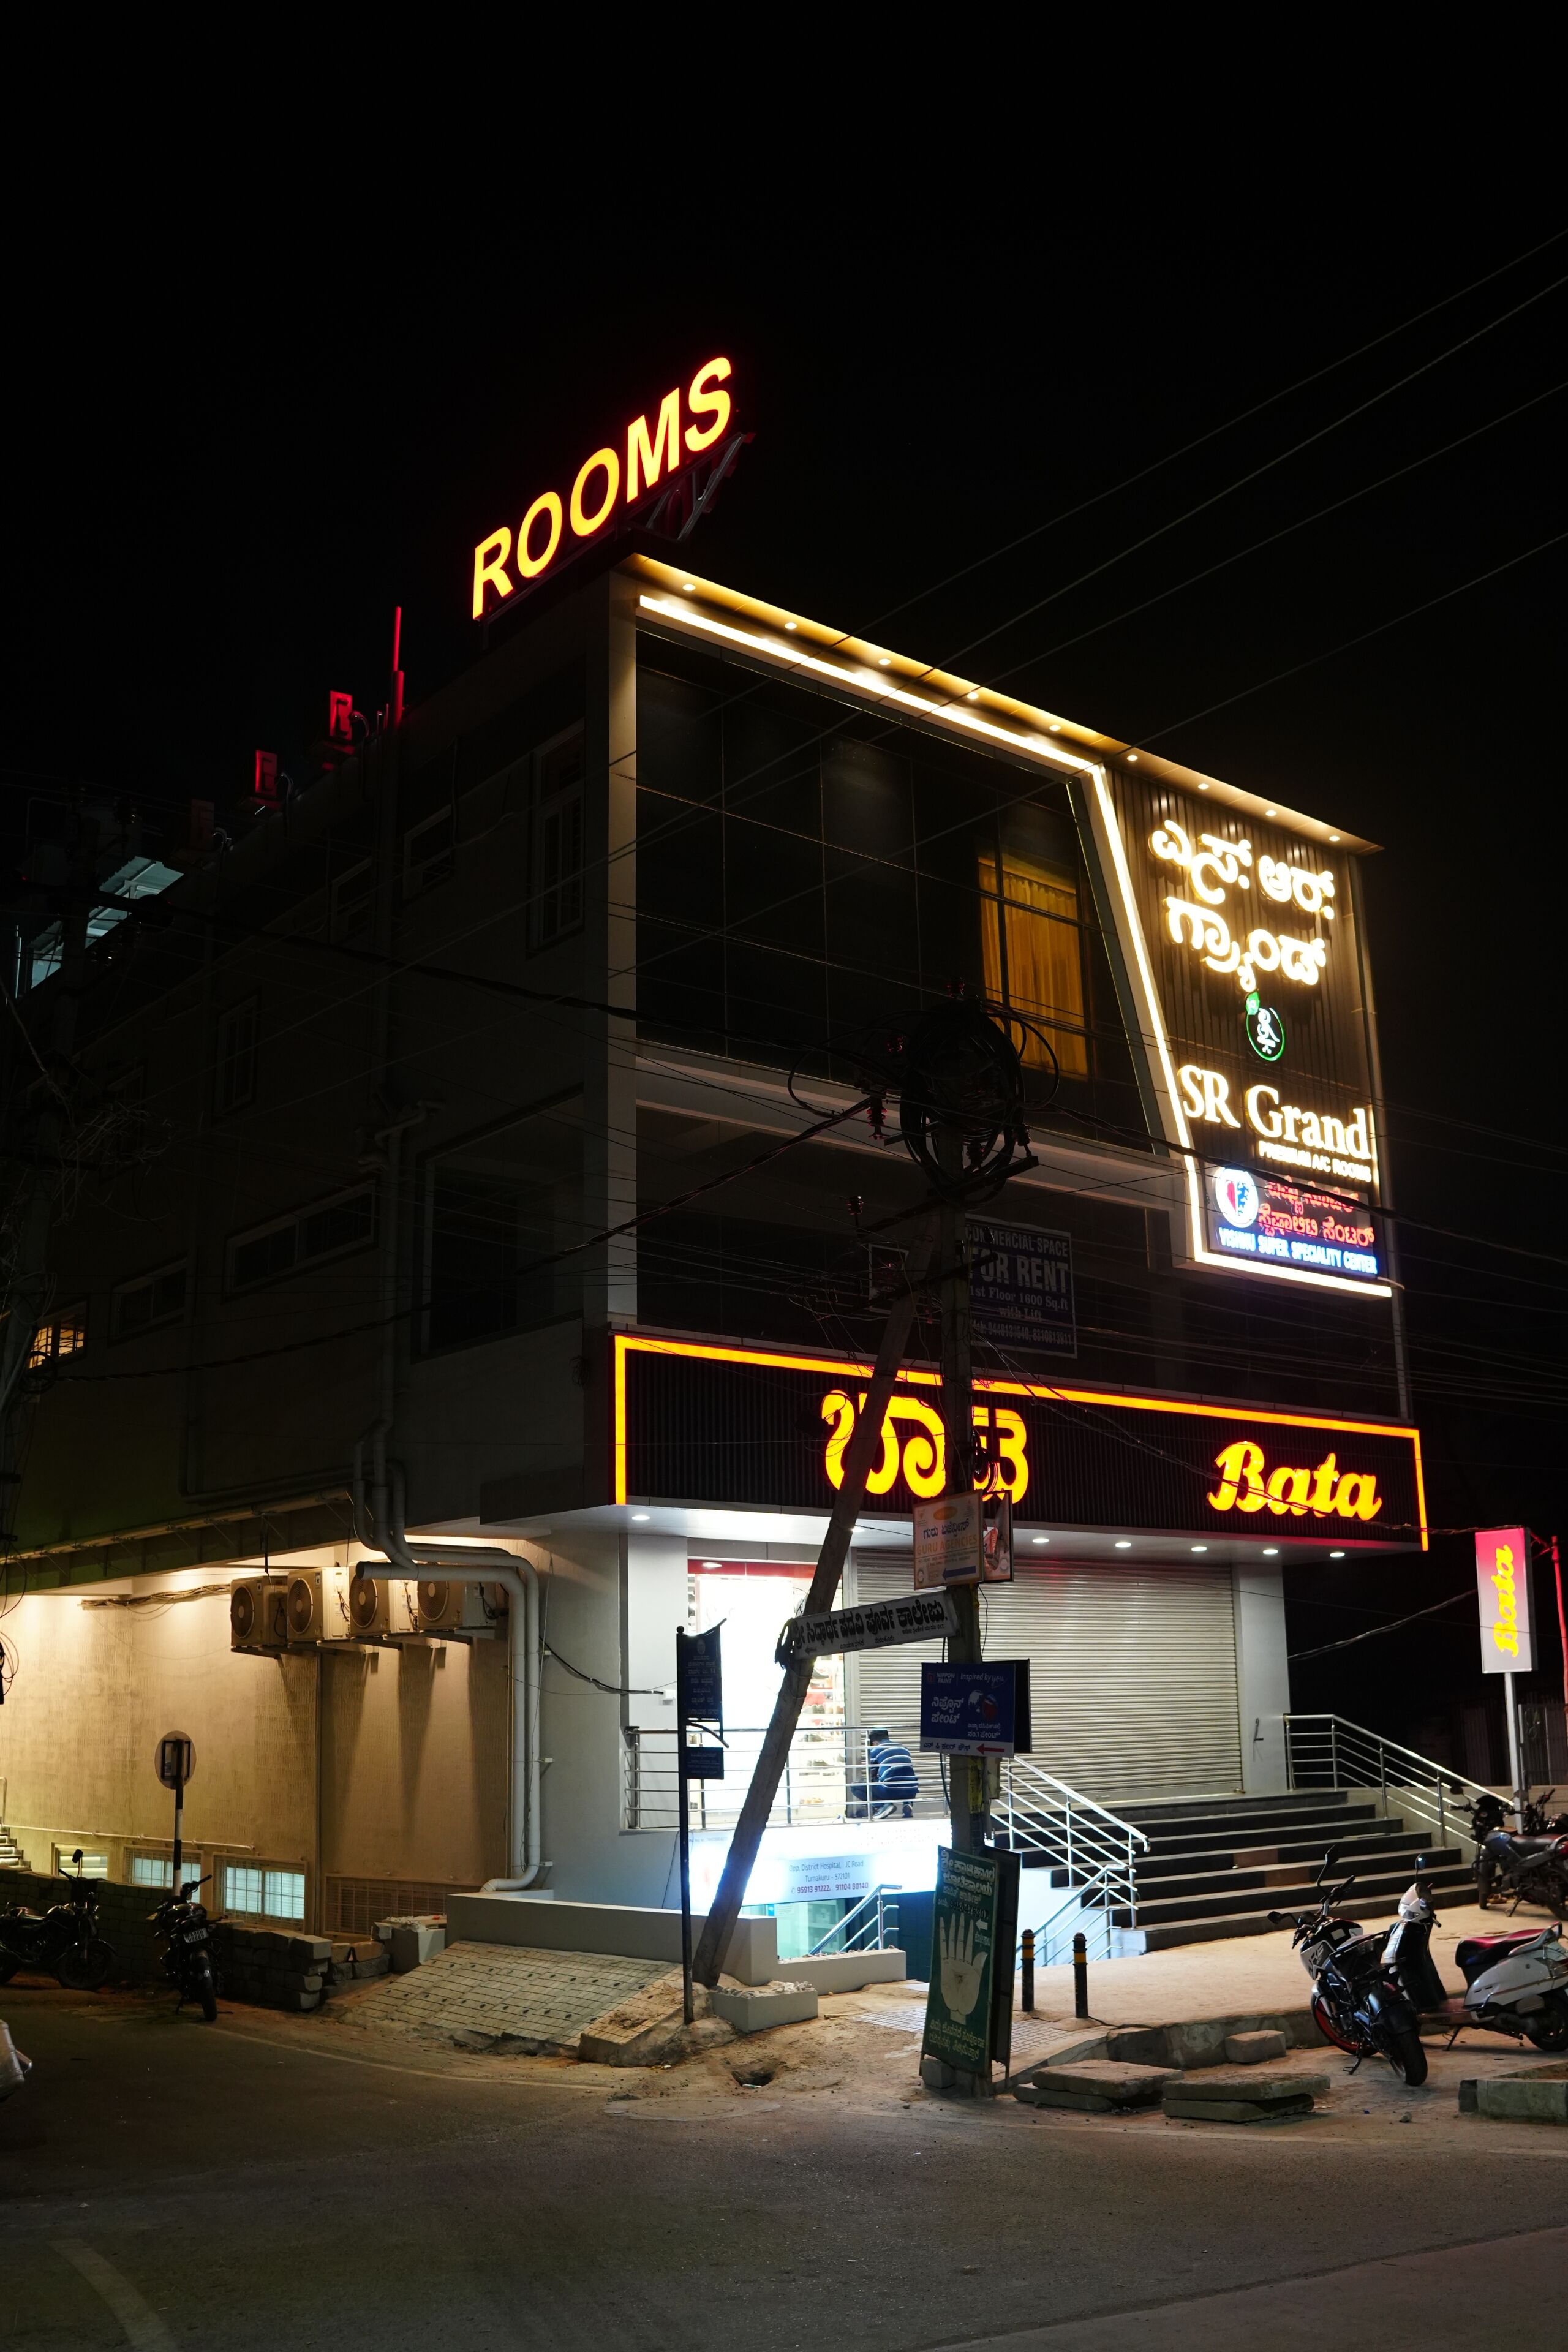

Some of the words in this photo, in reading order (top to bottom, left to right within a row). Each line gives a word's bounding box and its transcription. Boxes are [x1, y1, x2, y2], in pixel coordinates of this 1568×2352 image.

[473, 357, 731, 620] ROOMS
[1178, 1065, 1242, 1128] SR
[1246, 1085, 1372, 1160] Grand
[1259, 1140, 1311, 1168] PREMIUM
[1332, 1158, 1372, 1182] ROOMS
[965, 1224, 1035, 1252] COMERCIAL
[1037, 1237, 1068, 1257] SPACE
[1218, 1227, 1256, 1251] VISHNU
[1257, 1235, 1290, 1258] SUPER
[1291, 1241, 1342, 1268] SPECIALITY
[1343, 1251, 1378, 1275] CENTER
[1017, 1254, 1068, 1294] RENT
[989, 1287, 1016, 1302] Floor
[1019, 1293, 1042, 1306] 1600
[1206, 1440, 1382, 1521] Bata
[916, 1542, 938, 1555] GURU
[940, 1534, 978, 1551] AGENCIES
[1490, 1544, 1520, 1658] Bata
[839, 1611, 865, 1637] ಪದವಿ
[960, 1673, 983, 1682] Inspired
[984, 1673, 992, 1683] by
[931, 1711, 960, 1724] ಪೇಂಟ್
[820, 1861, 841, 1871] Hospital,
